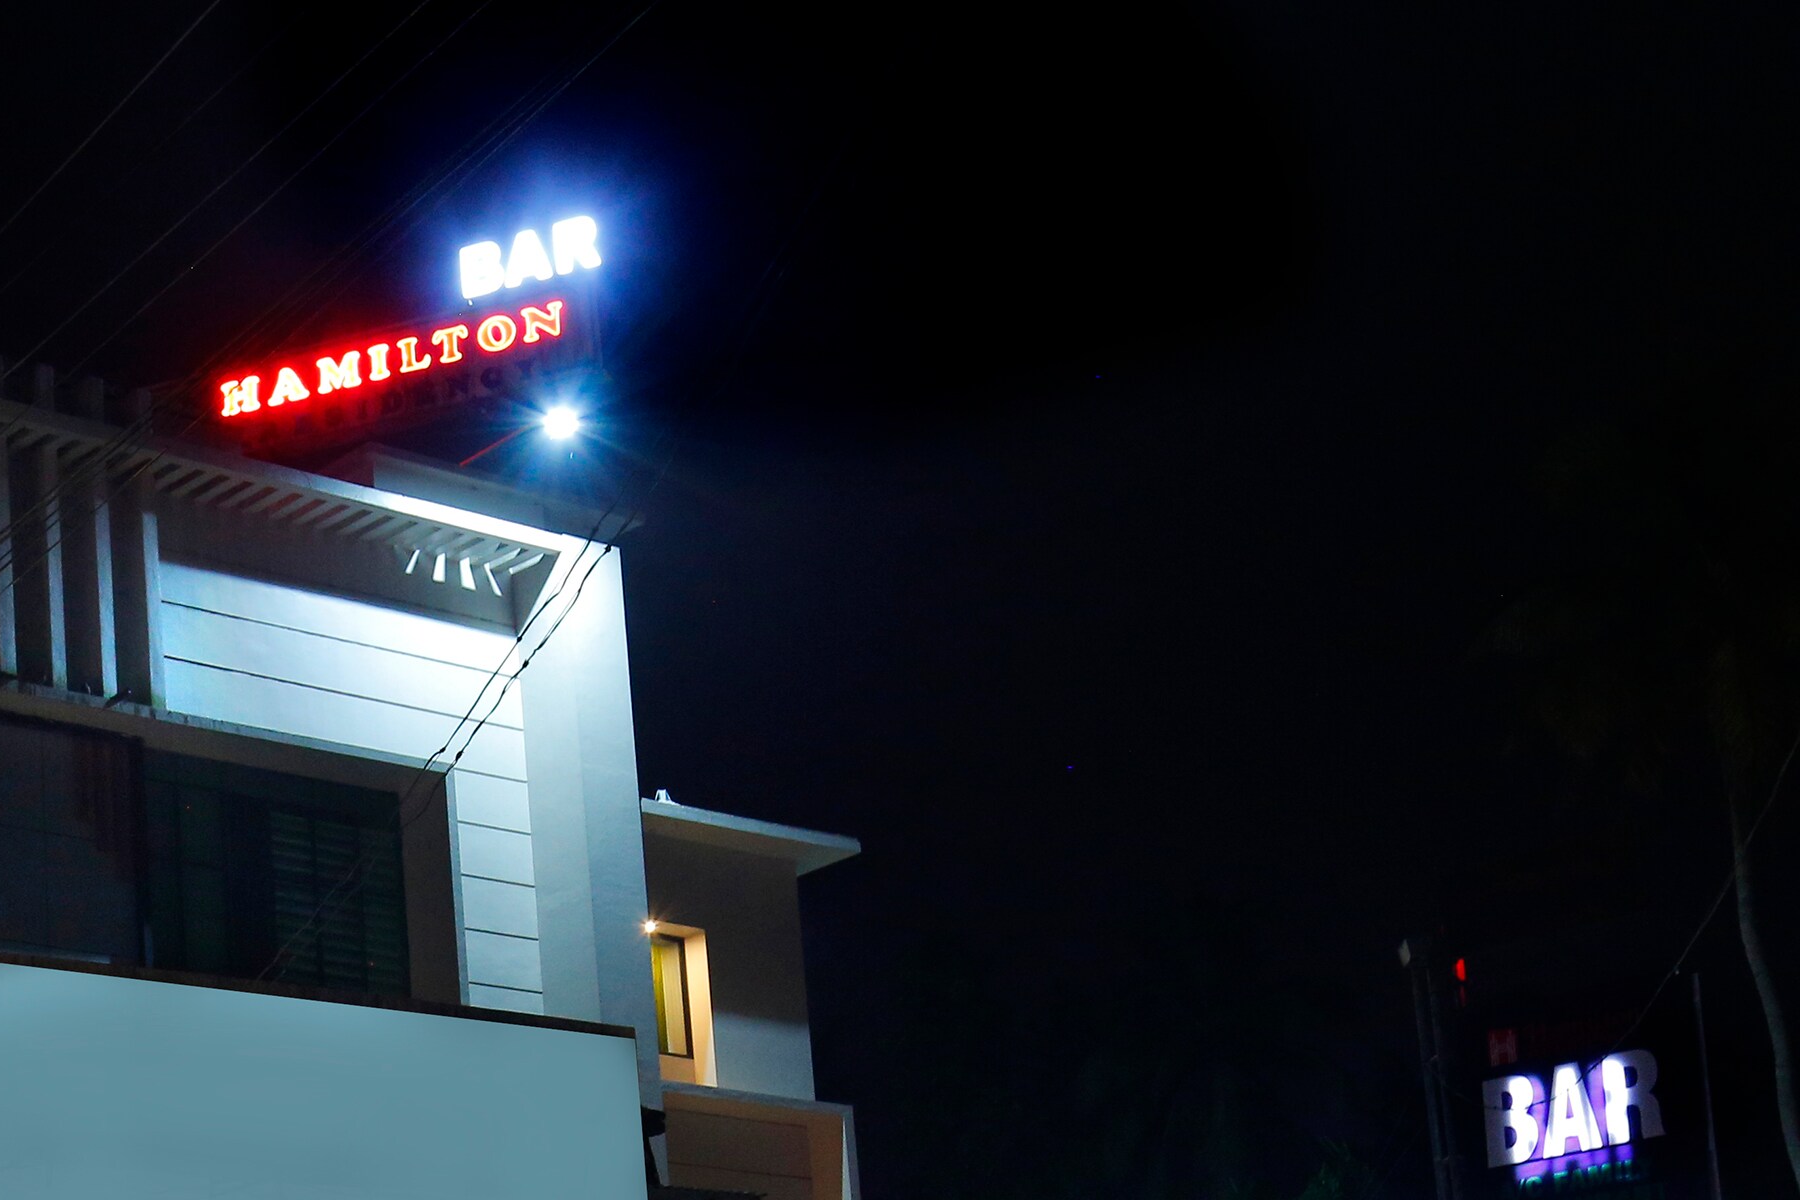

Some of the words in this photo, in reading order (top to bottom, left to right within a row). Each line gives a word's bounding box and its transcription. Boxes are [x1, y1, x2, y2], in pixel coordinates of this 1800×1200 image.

[459, 216, 602, 299] BAR
[221, 301, 563, 416] HAMILTON
[1482, 1049, 1667, 1168] BAR
